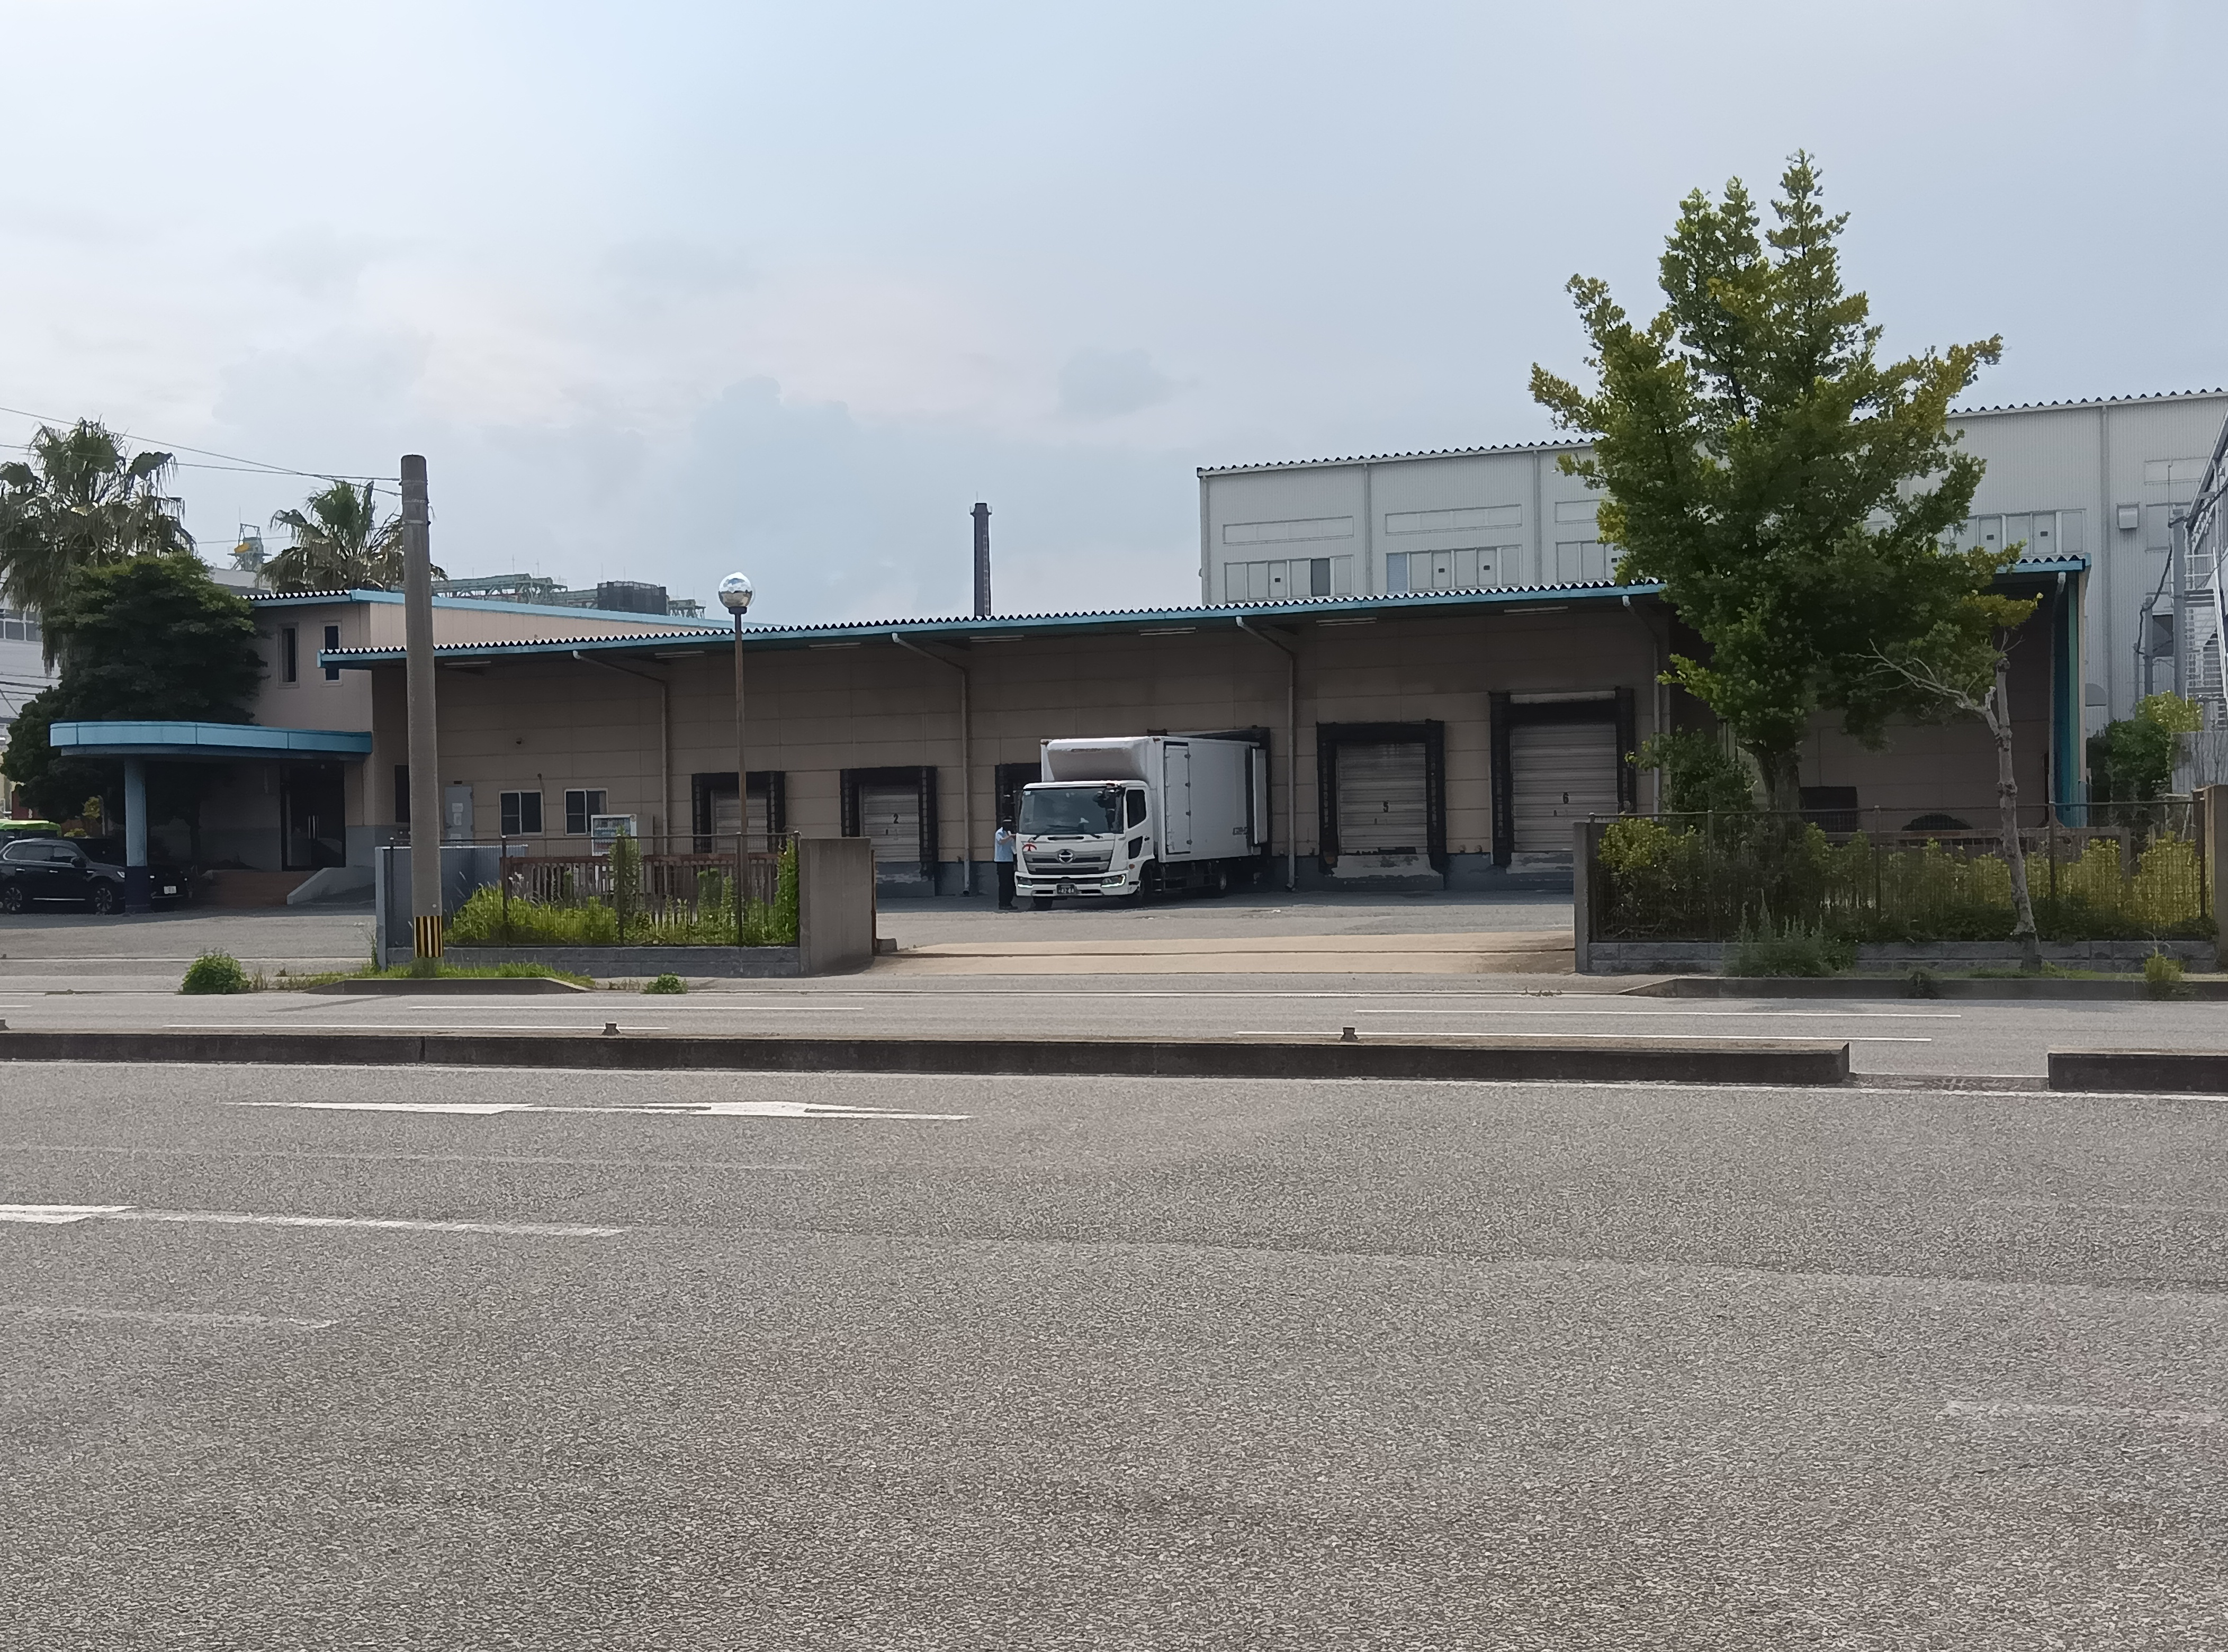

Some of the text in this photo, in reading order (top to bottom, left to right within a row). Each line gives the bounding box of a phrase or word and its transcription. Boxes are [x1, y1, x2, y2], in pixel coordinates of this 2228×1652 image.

[1563, 792, 1569, 804] 6
[1383, 801, 1389, 813] 5
[894, 813, 899, 823] 2
